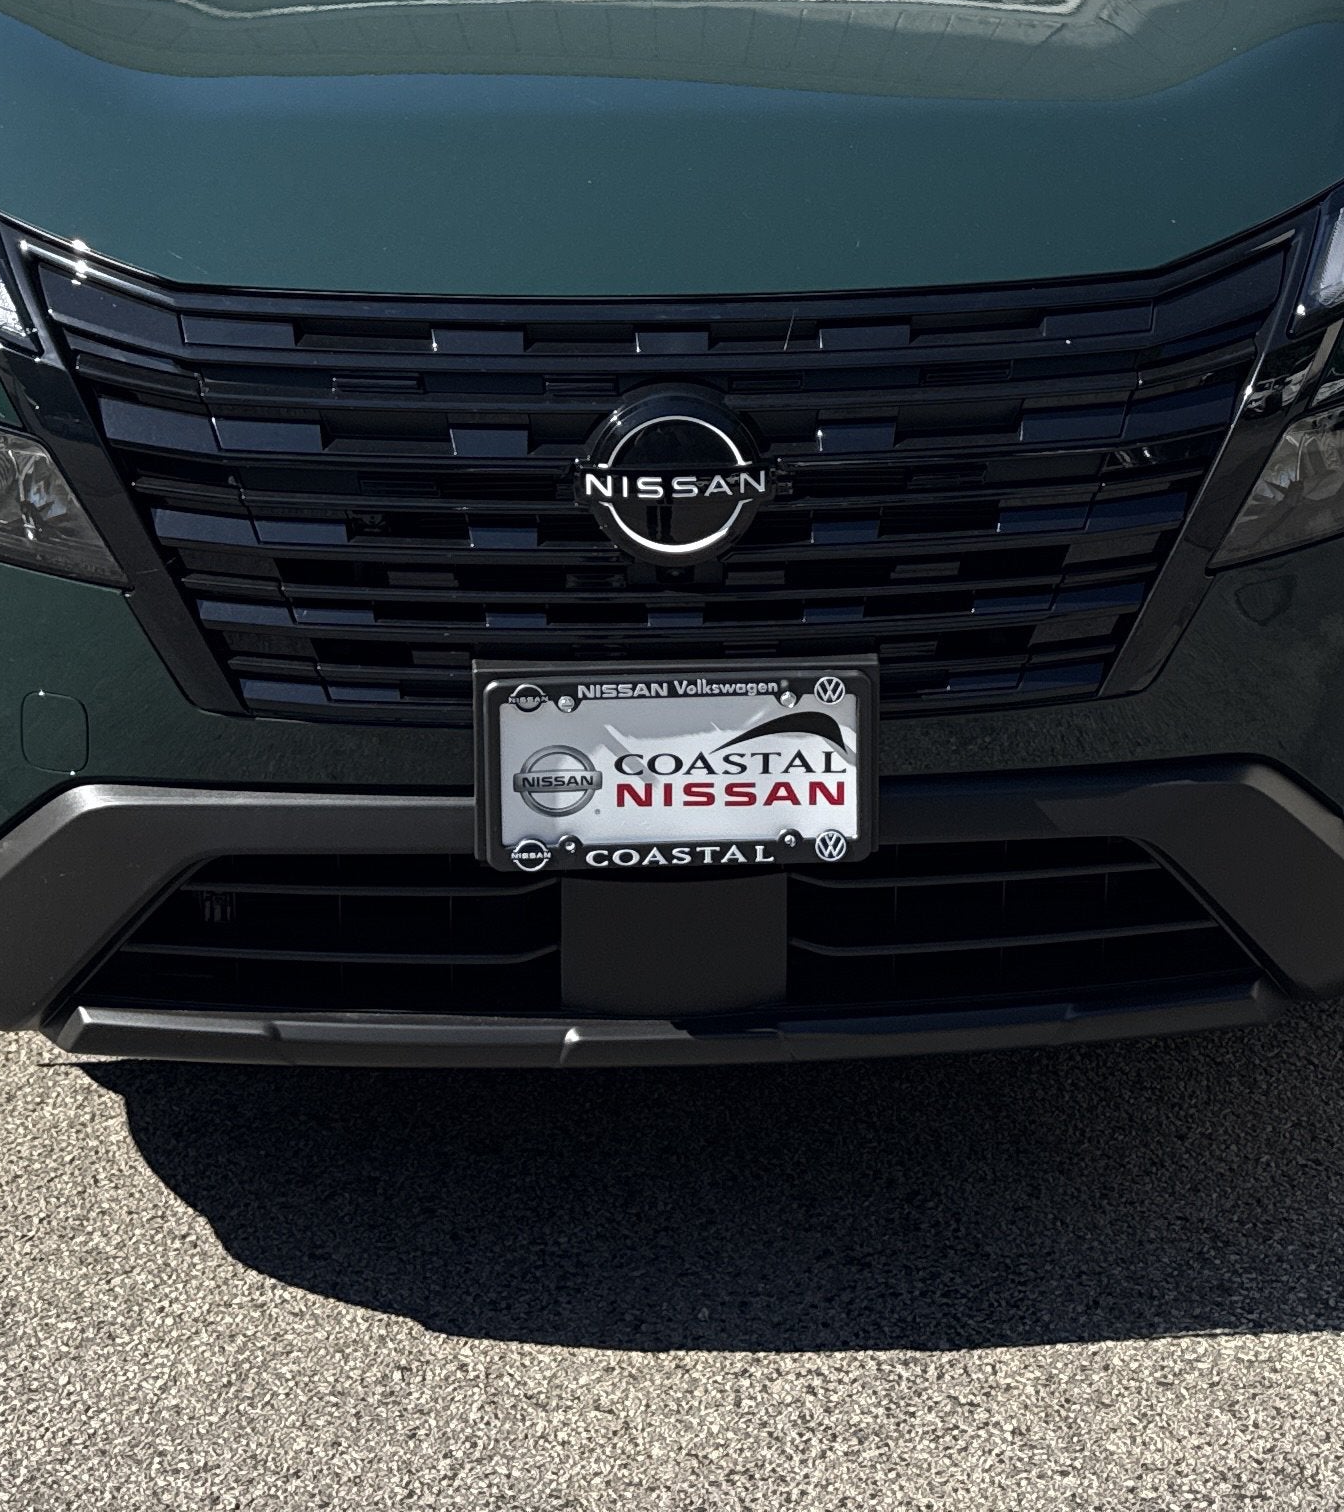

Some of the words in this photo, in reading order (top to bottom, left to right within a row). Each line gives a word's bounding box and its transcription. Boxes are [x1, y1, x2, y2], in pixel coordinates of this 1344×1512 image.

[585, 470, 766, 498] NISSAN
[508, 695, 549, 704] NISSAN
[577, 682, 668, 699] NISSAN
[674, 678, 778, 695] Volkswagen
[614, 748, 847, 776] COASTAL
[522, 775, 594, 788] NISSAN
[616, 781, 845, 807] NISSAN
[511, 852, 551, 860] NISSAN
[585, 844, 775, 867] COASTAL
